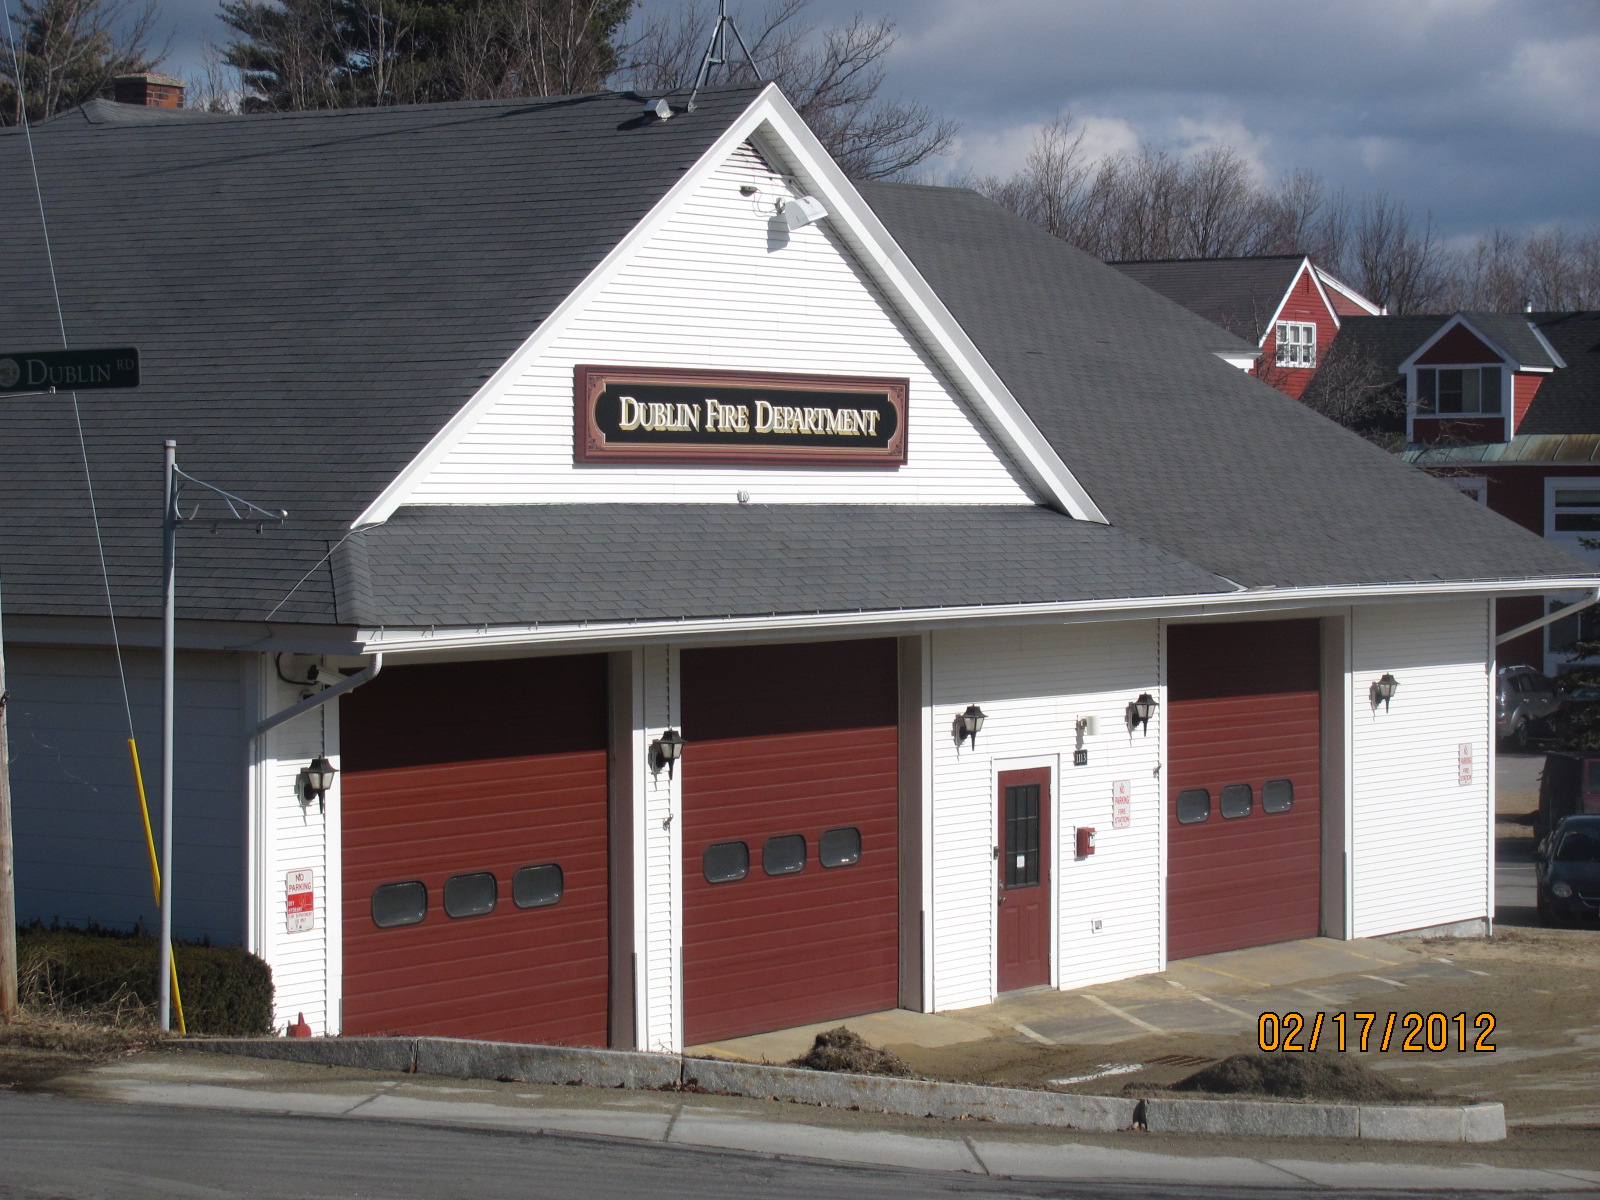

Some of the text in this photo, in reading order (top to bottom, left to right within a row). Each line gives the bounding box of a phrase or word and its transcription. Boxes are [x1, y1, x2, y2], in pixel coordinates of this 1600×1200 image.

[26, 358, 135, 385] DUBLIN RD
[619, 396, 880, 436] DUBLIN FIRE DEPARTMENT
[1115, 795, 1130, 805] PARKING
[1115, 816, 1130, 824] STATION
[295, 873, 304, 882] NO
[288, 882, 312, 892] PARKING
